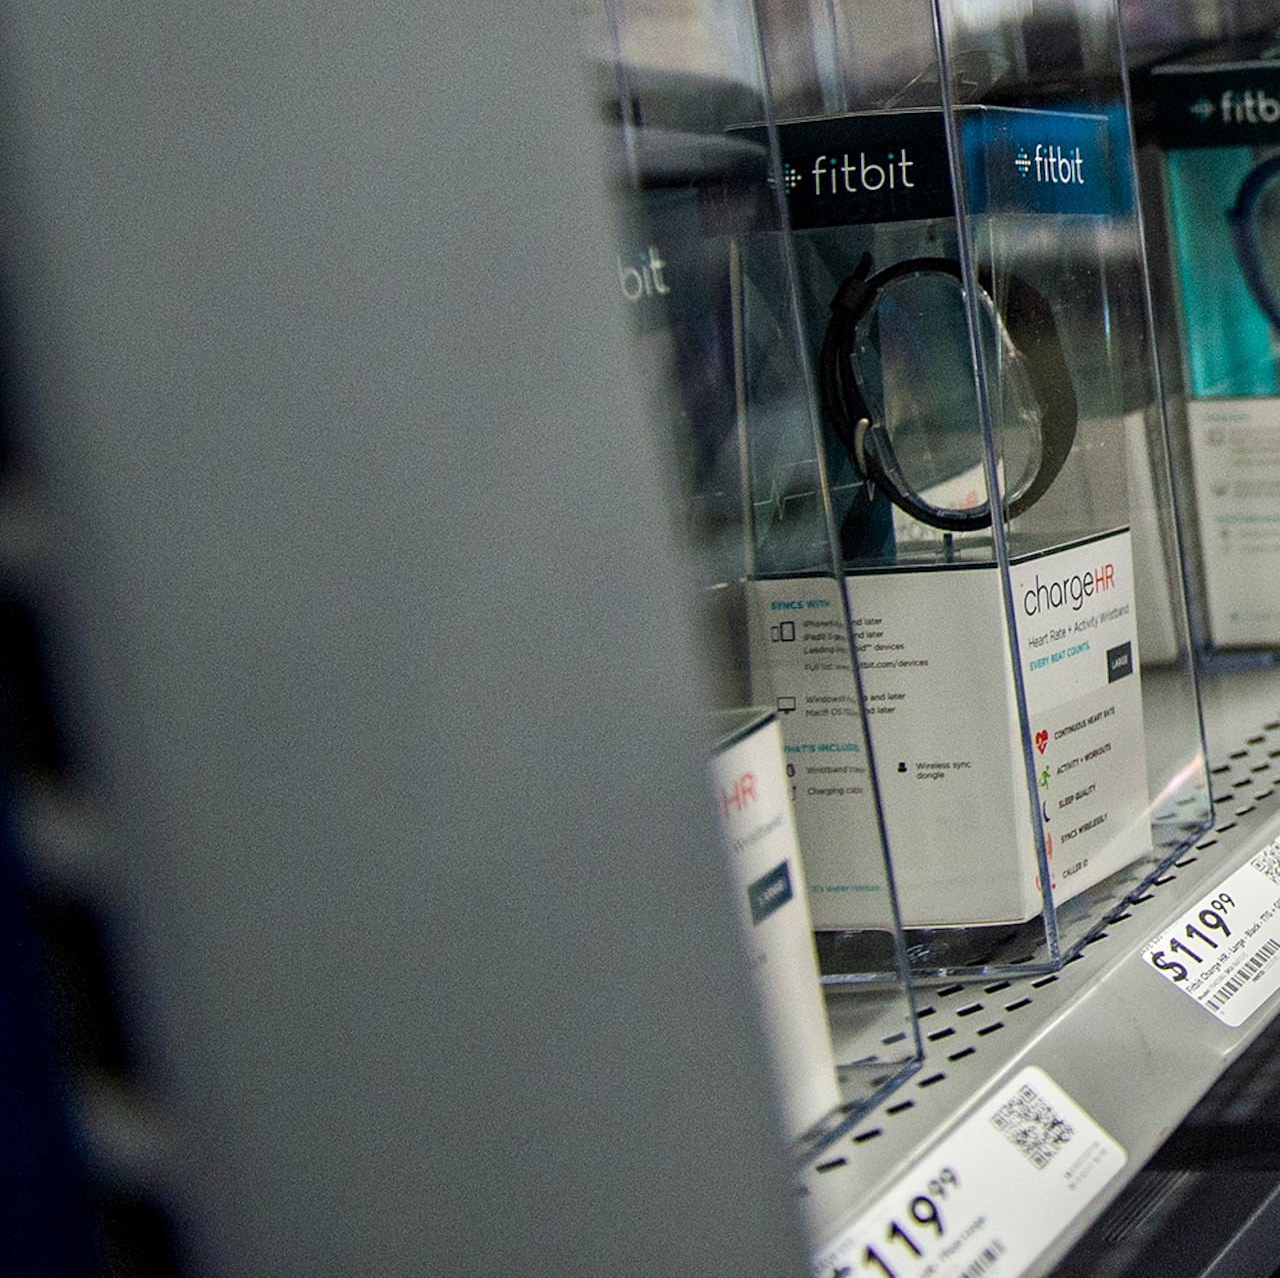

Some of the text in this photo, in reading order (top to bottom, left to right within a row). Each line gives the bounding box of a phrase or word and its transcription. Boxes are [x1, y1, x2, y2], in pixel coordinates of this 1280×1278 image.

[811, 149, 915, 195] fitbit
[1035, 144, 1084, 184] fitbit
[616, 244, 671, 301] bit
[770, 600, 803, 610] SYNCS
[1028, 632, 1049, 649] Heart
[1050, 627, 1067, 642] Rate
[1073, 616, 1098, 634] Activity
[1099, 602, 1129, 624] Wristband
[874, 643, 904, 651] devices
[1029, 657, 1050, 672] EVERY
[1051, 650, 1067, 663] BEAT
[1111, 654, 1128, 670] LARGE
[887, 692, 906, 701] later
[877, 706, 896, 714] later
[1054, 706, 1116, 740] CONTINUOUS HEART RATE
[916, 761, 971, 771] Wireless sync
[1056, 758, 1080, 775] ACTIVITY
[1084, 742, 1112, 762] WORKOUTS
[916, 771, 945, 781] dongle
[808, 787, 844, 796] Charging
[1058, 783, 1097, 809] SLEEP QUALITY
[1060, 813, 1108, 844] SYNCS WIRELESSLY
[1062, 862, 1084, 878] CALLER
[1186, 975, 1203, 994] Fitbit
[1200, 961, 1221, 981] Charge
[1218, 953, 1229, 964] HR
[1230, 938, 1246, 954] Large
[1245, 923, 1261, 938] Black
